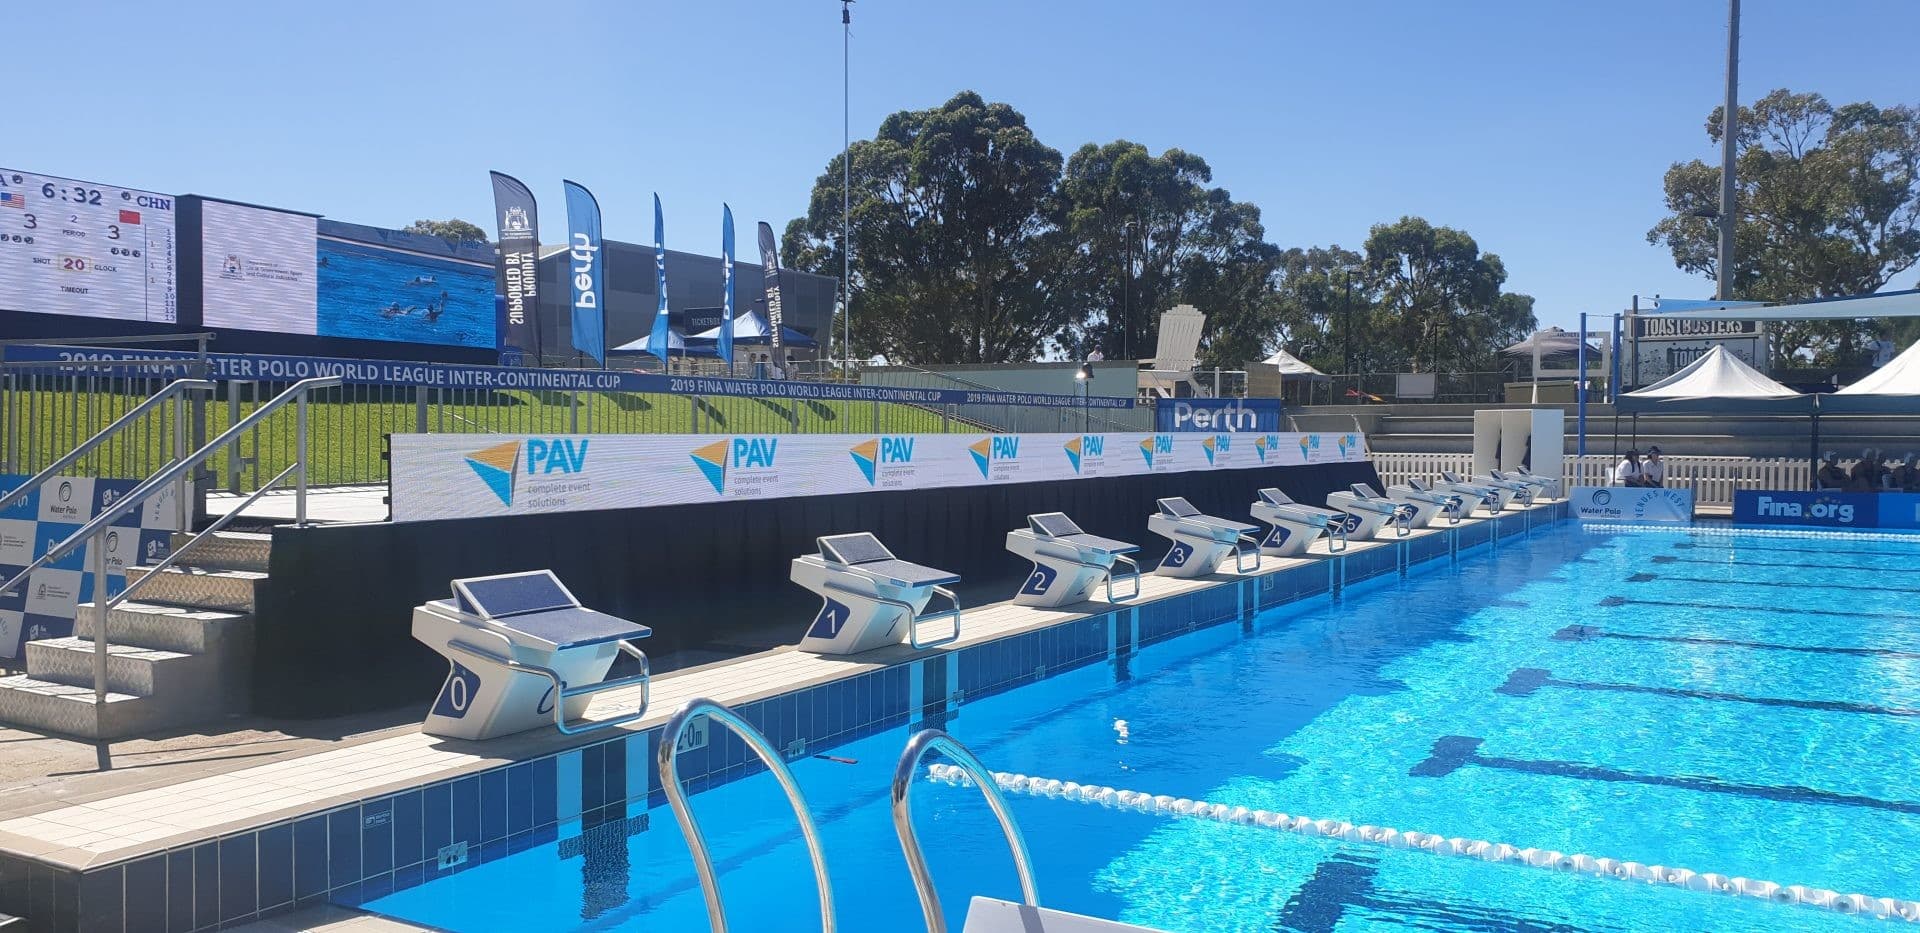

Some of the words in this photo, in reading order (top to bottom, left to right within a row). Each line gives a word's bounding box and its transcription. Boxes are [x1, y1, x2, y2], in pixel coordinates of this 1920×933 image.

[42, 183, 102, 206] 6:32
[136, 196, 170, 210] CHN
[24, 214, 37, 229] 3
[71, 215, 78, 224] 2
[62, 229, 86, 237] PERIOD
[108, 225, 120, 240] 3
[64, 258, 85, 270] 20
[94, 264, 117, 272] CLOCK
[61, 286, 88, 294] TIMEOUT
[258, 360, 308, 378] POLO
[314, 362, 378, 380] WORLD
[384, 366, 444, 384] LEAGUE
[449, 370, 594, 388] INTER-CONTINENTAL
[596, 374, 621, 388] CUP
[670, 379, 695, 392] 2019
[699, 380, 723, 394] FINA
[723, 382, 758, 394] WATER
[760, 383, 786, 395] POLO
[788, 385, 819, 397] WORLD
[821, 386, 851, 398] LEAGUE
[854, 388, 926, 400] INTER-CONTINENTAL
[928, 391, 942, 401] CUP
[966, 393, 981, 403] 2019
[996, 394, 1017, 404] WATER
[1018, 395, 1032, 404] POLO
[1032, 396, 1051, 405] WORLD
[1052, 396, 1071, 406] LEAGUE
[1174, 402, 1256, 432] Perth
[993, 436, 1020, 459] PAV
[1083, 436, 1104, 456] PAV
[1156, 435, 1173, 454] PAV
[1215, 435, 1231, 452] PAV
[1266, 435, 1280, 450] PAV
[1309, 434, 1320, 449] PAV
[527, 438, 589, 475] PAV
[734, 437, 777, 468] PAV
[881, 437, 914, 463] PAV
[734, 476, 761, 486] complete
[762, 474, 778, 483] event
[528, 482, 566, 494] complete
[568, 483, 590, 492] event
[734, 487, 761, 496] solutions
[50, 504, 65, 513] Water
[66, 506, 78, 514] Polo
[528, 497, 566, 508] solutions
[1635, 490, 1659, 518] VENUES
[1663, 489, 1686, 506] WEST
[1348, 518, 1355, 531] 5
[1272, 531, 1282, 545] 4
[1174, 547, 1184, 564] 3
[1034, 572, 1046, 591] 2
[826, 609, 836, 633] 1
[451, 676, 466, 711] 0
